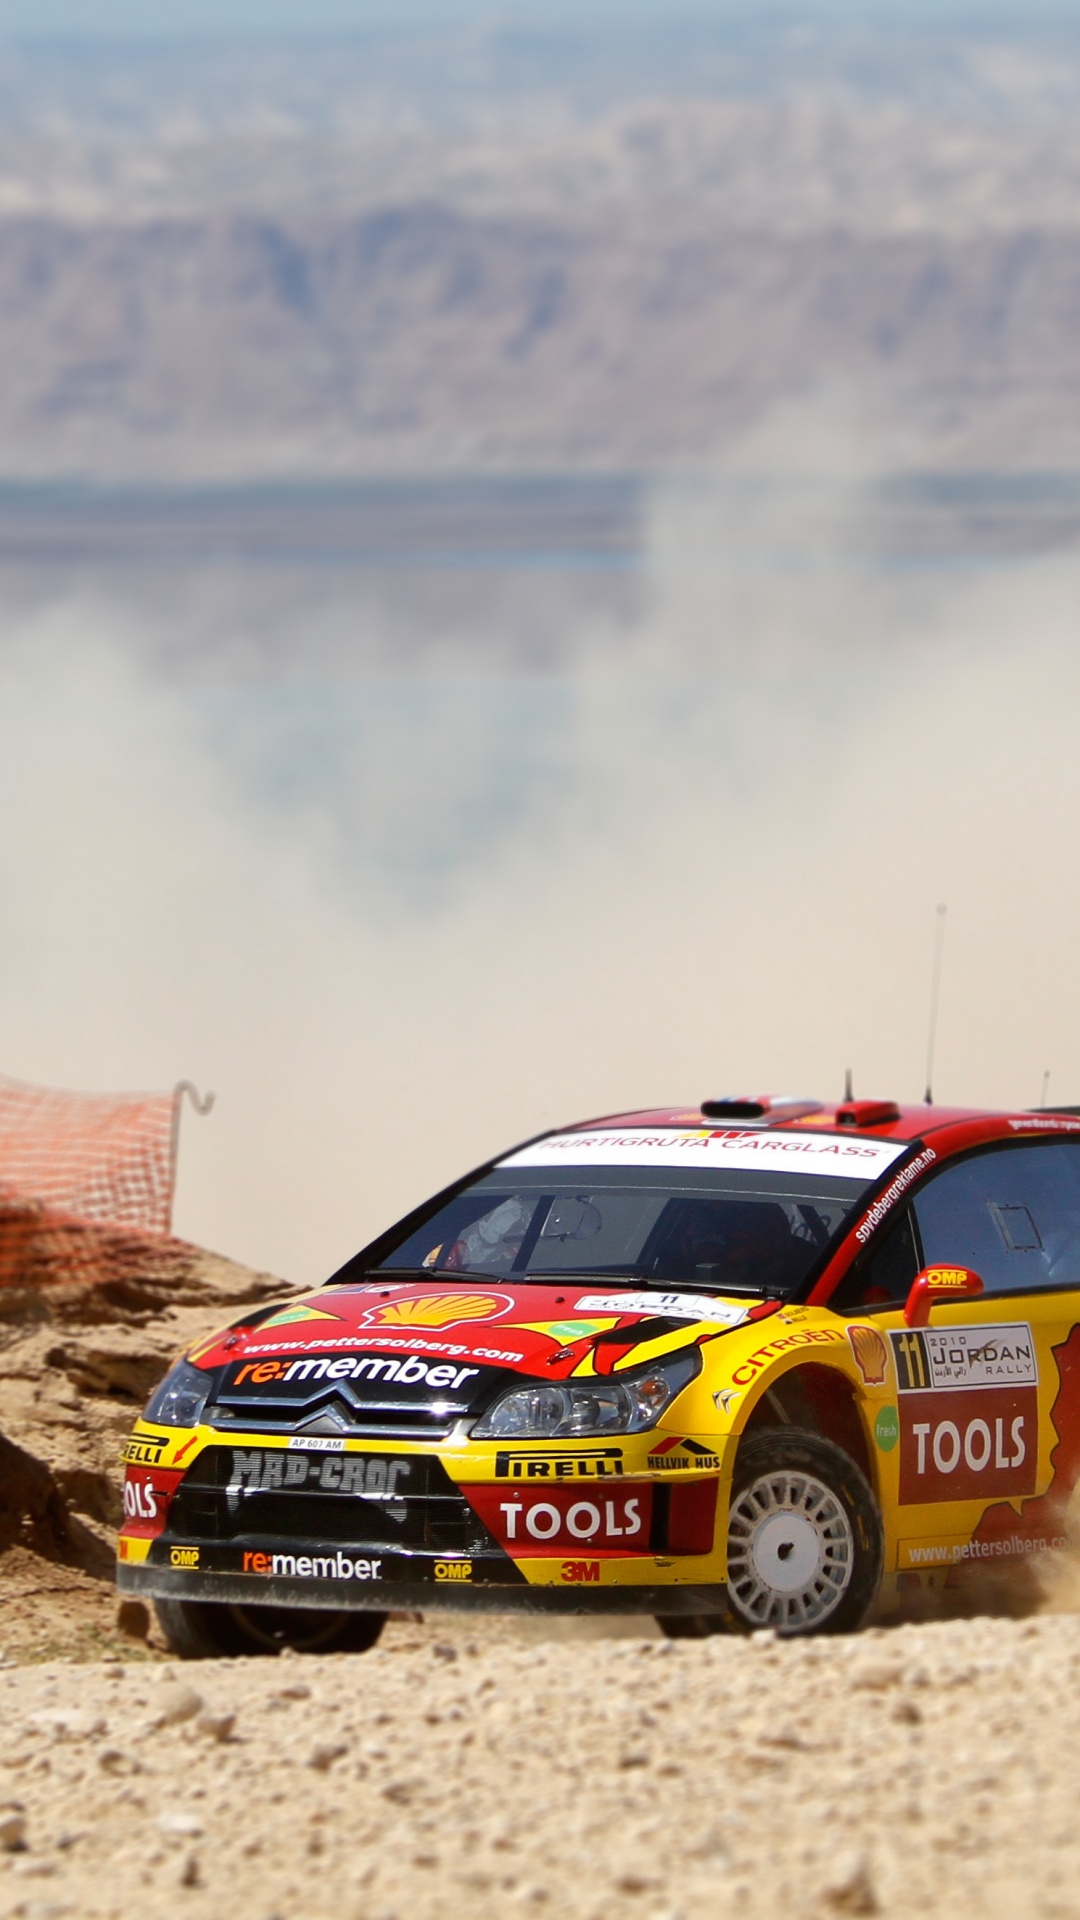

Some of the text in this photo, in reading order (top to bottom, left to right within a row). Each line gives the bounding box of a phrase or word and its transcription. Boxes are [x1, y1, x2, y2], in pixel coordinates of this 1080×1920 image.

[540, 1136, 880, 1158] HURTIGRUTA CARGLASS
[855, 1147, 937, 1244] spydebergreklame.no
[926, 1271, 968, 1286] OMP
[660, 1295, 681, 1304] 11
[243, 1335, 524, 1363] www.pettersolberg.com
[930, 1336, 967, 1347] 2010
[898, 1333, 926, 1388] 11
[932, 1344, 1031, 1366] JORDAN
[233, 1354, 480, 1390] re:member
[985, 1363, 1033, 1376] RALLY
[876, 1423, 897, 1437] fresh
[291, 1438, 342, 1450] AP 607 AM
[912, 1415, 1026, 1475] TOOLS
[495, 1447, 623, 1478] PIRELLI
[647, 1455, 720, 1470] HELLVIK HUS
[124, 1480, 157, 1518] OLS
[499, 1498, 642, 1540] TOOLS
[169, 1549, 200, 1566] OMP
[242, 1551, 383, 1580] re:member
[433, 1562, 473, 1580] OMP
[560, 1560, 600, 1582] 3M
